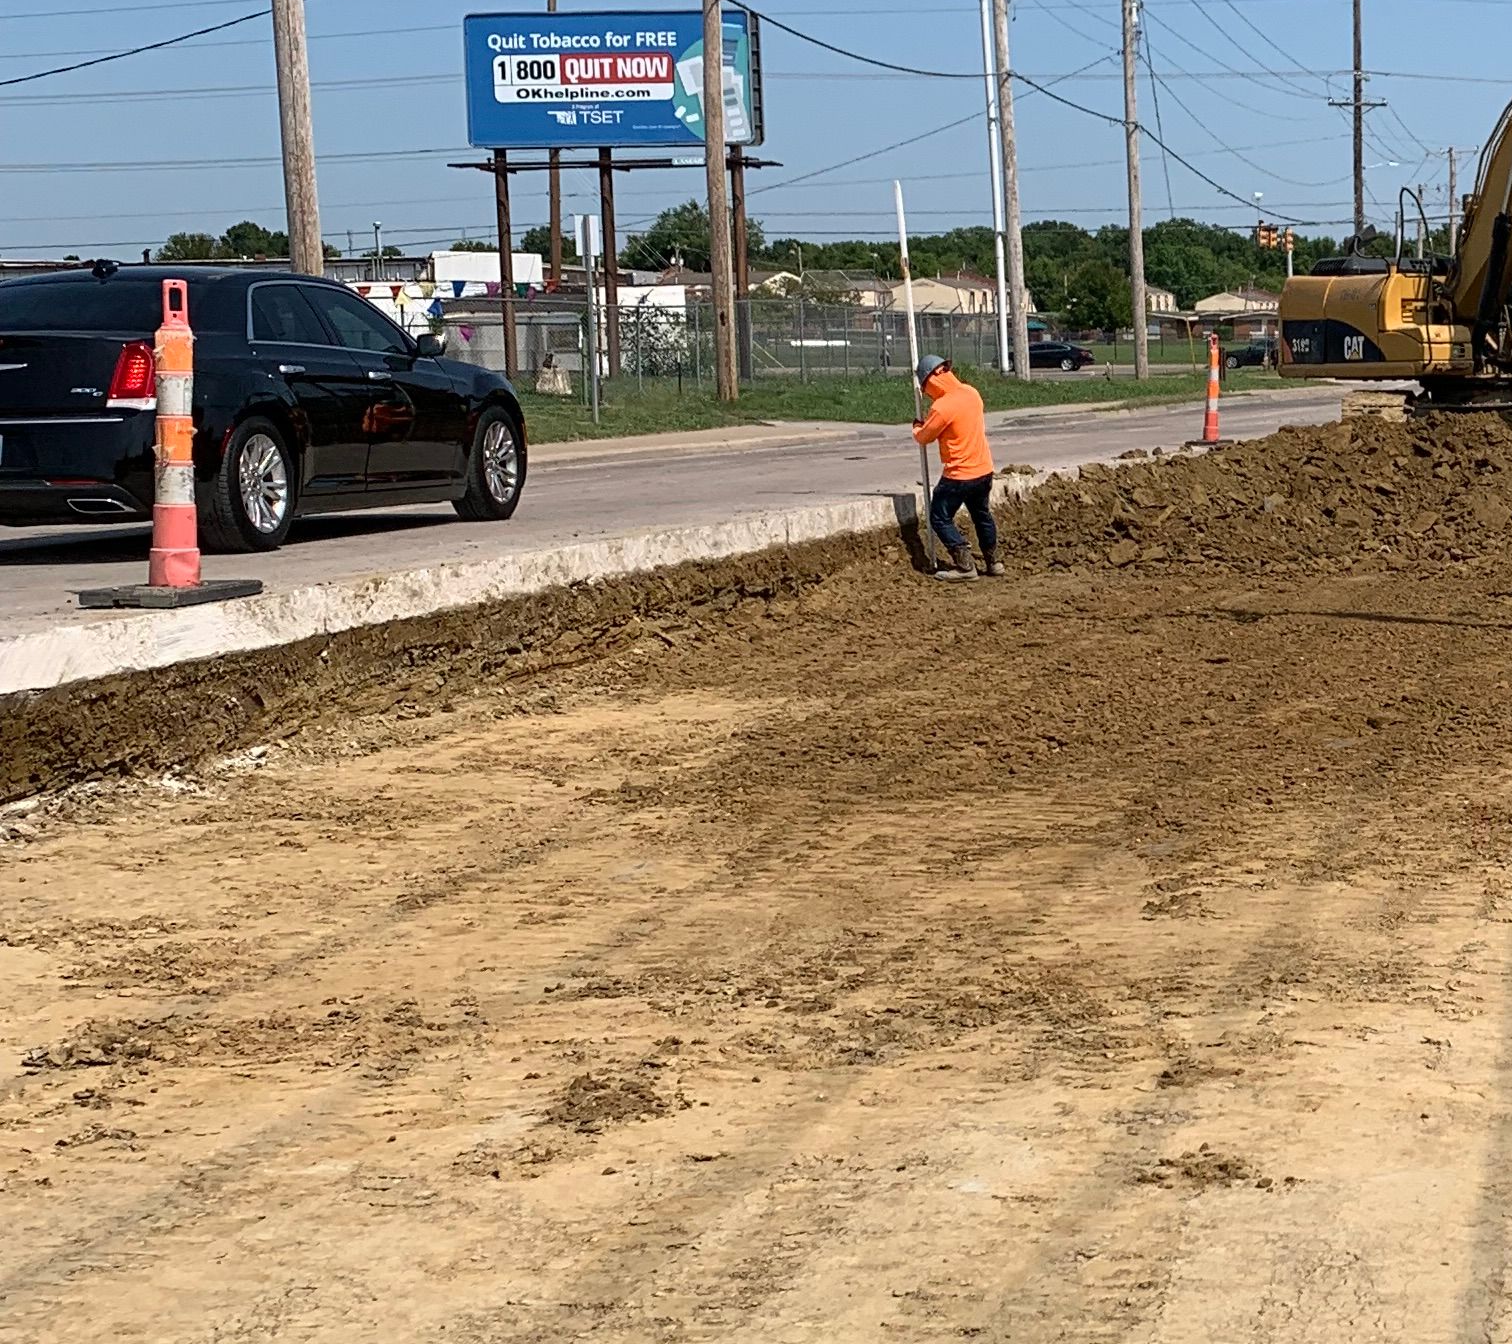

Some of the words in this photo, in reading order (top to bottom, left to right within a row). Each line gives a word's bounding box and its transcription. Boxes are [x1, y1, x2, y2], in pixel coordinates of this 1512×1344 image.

[488, 33, 526, 52] Quit
[530, 32, 600, 48] Tobacco
[605, 32, 631, 47] for
[636, 31, 677, 47] FREE
[497, 61, 507, 80] 1
[516, 60, 556, 80] 800
[565, 58, 613, 83] QUIT
[617, 57, 668, 79] NOW
[516, 87, 651, 101] OKhelpline.com
[579, 110, 624, 124] TSET
[1344, 336, 1365, 360] CAT
